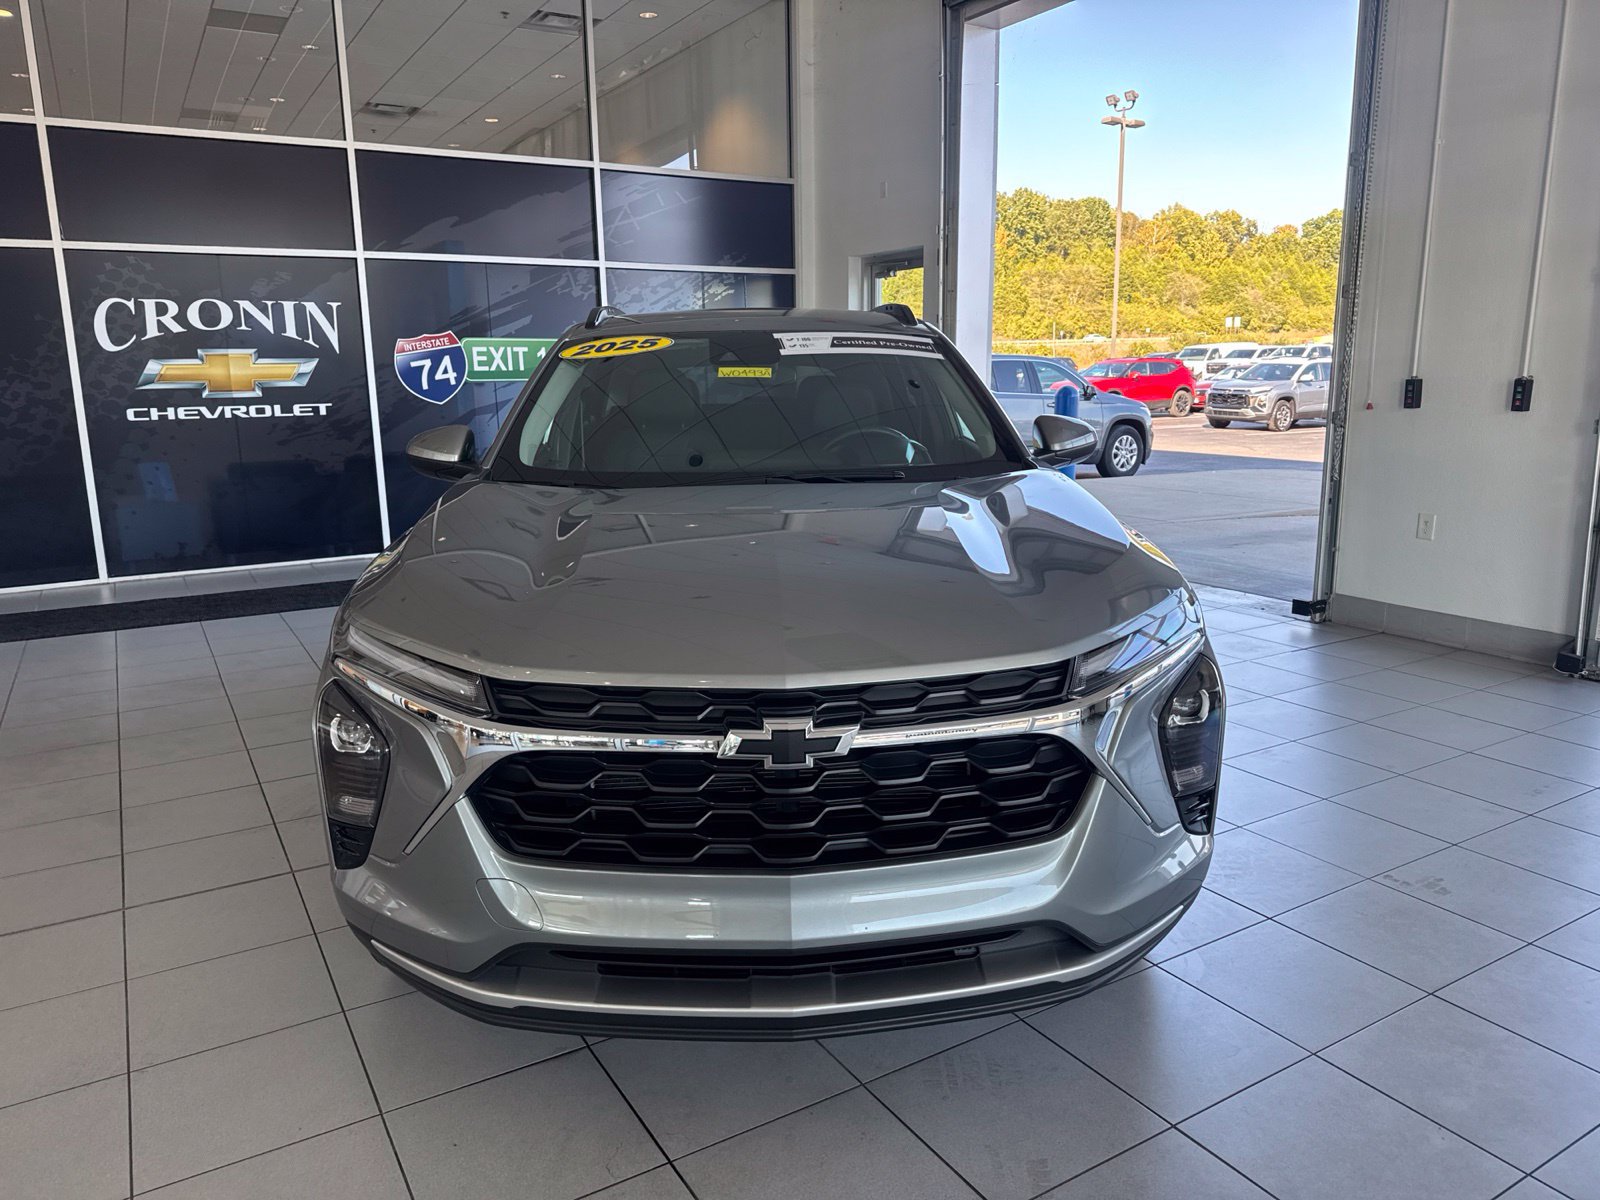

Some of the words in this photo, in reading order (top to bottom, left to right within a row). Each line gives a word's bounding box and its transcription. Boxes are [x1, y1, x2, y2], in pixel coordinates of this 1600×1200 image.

[93, 297, 342, 354] CRONIN
[403, 337, 450, 352] INTERSTATE
[570, 338, 662, 357] 2025
[880, 341, 933, 350] Pre-Owned
[471, 346, 529, 371] EXIT
[410, 355, 457, 390] 74
[126, 403, 333, 421] CHEVROLET
